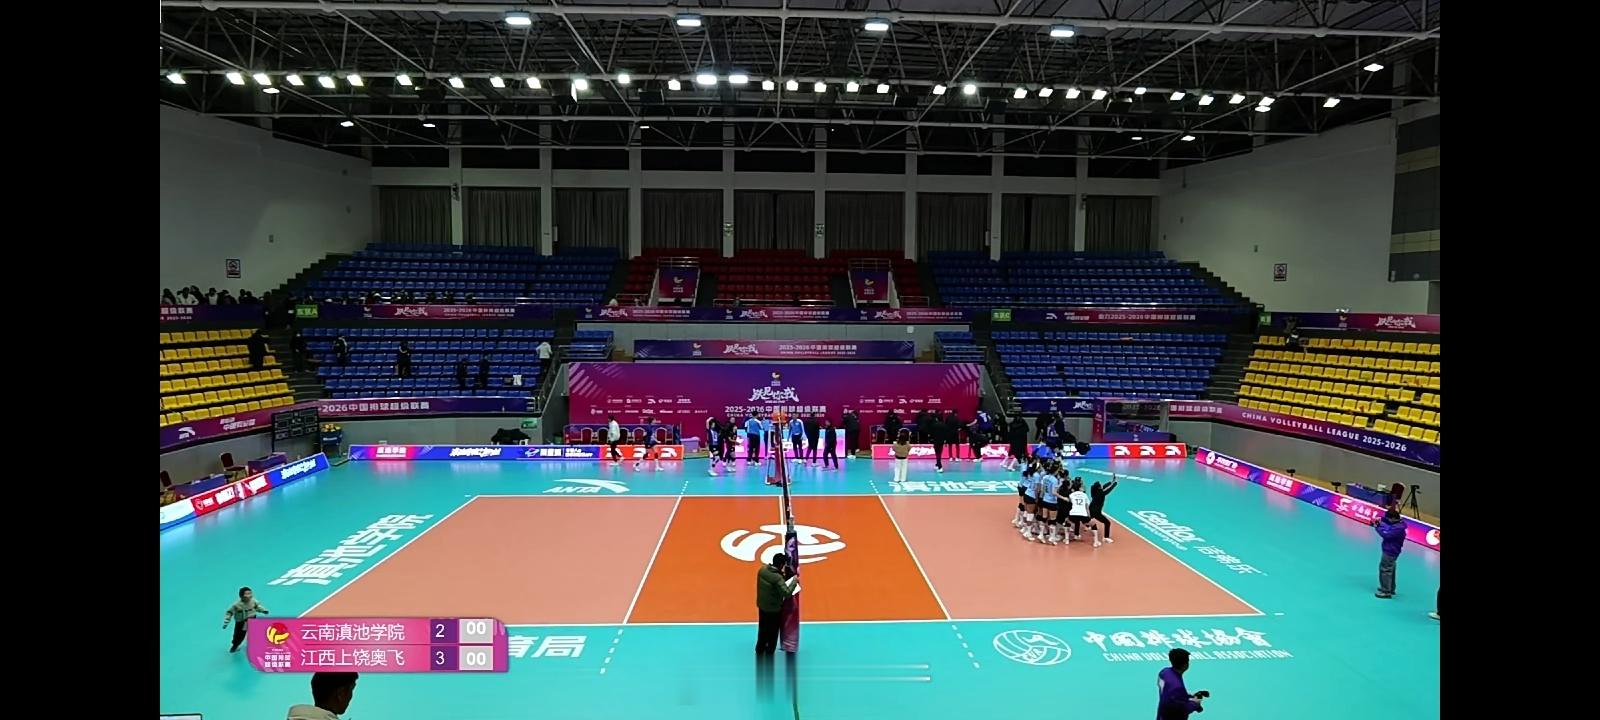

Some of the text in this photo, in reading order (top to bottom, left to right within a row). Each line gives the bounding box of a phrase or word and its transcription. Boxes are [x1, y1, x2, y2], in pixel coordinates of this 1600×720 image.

[1241, 411, 1408, 452] CHINA VOLLEYBALL LEAGUE 2025-2026
[1102, 652, 1143, 661] CHINA
[1213, 650, 1295, 660] ASSOCIATION
